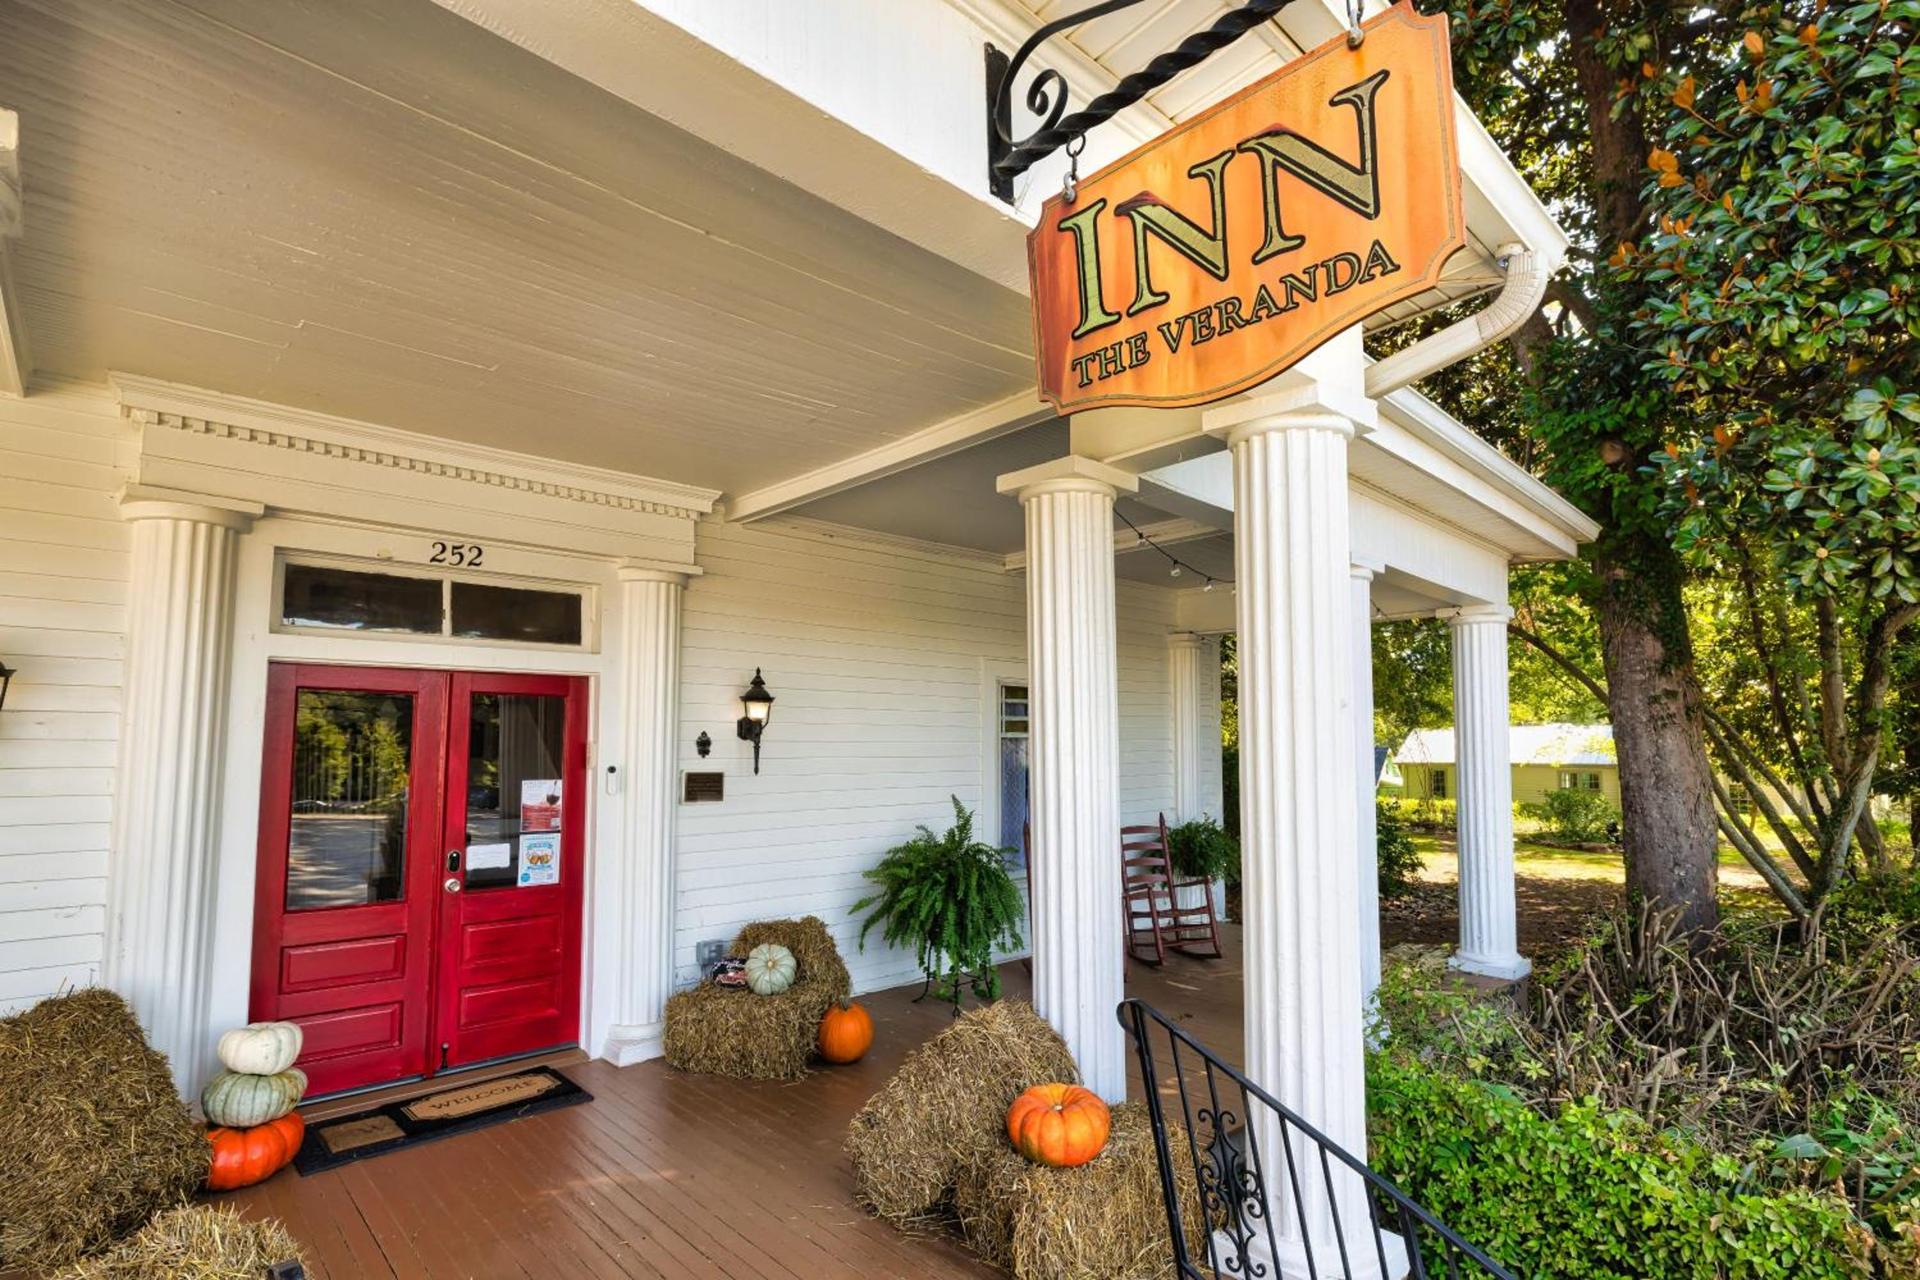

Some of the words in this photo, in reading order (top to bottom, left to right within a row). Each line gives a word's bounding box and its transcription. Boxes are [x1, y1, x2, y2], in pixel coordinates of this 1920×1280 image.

[1058, 69, 1390, 340] INN
[1072, 332, 1150, 388] THE
[1158, 239, 1400, 354] VERANDA
[430, 541, 483, 567] 252
[429, 1080, 537, 1109] WELCOME
